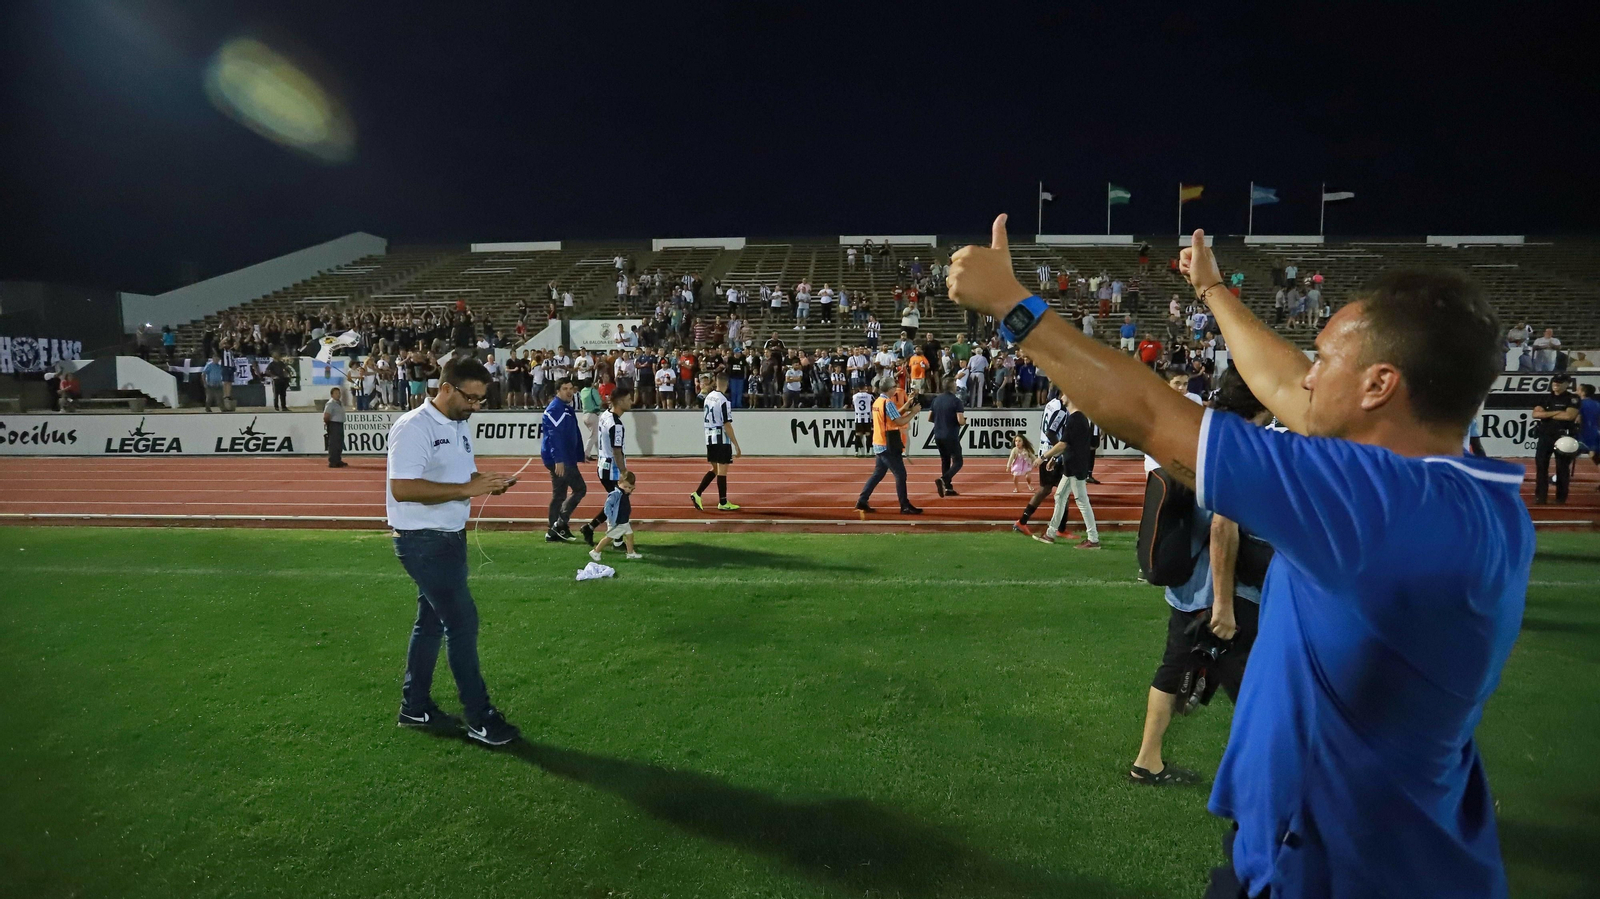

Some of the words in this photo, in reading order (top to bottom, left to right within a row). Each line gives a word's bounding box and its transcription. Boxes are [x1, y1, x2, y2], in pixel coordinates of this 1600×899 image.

[858, 400, 866, 410] 3
[347, 414, 383, 422] UEBLES
[387, 414, 392, 422] Y
[705, 404, 716, 423] 21
[823, 419, 855, 428] PINT
[970, 418, 1027, 427] INDUSTRIAS
[1481, 413, 1541, 445] Roja
[105, 438, 182, 453] LEGEA
[215, 437, 294, 452] LEGEA
[969, 430, 1026, 449] LACS
[1524, 442, 1537, 450] CO
[1181, 671, 1190, 693] Canon
